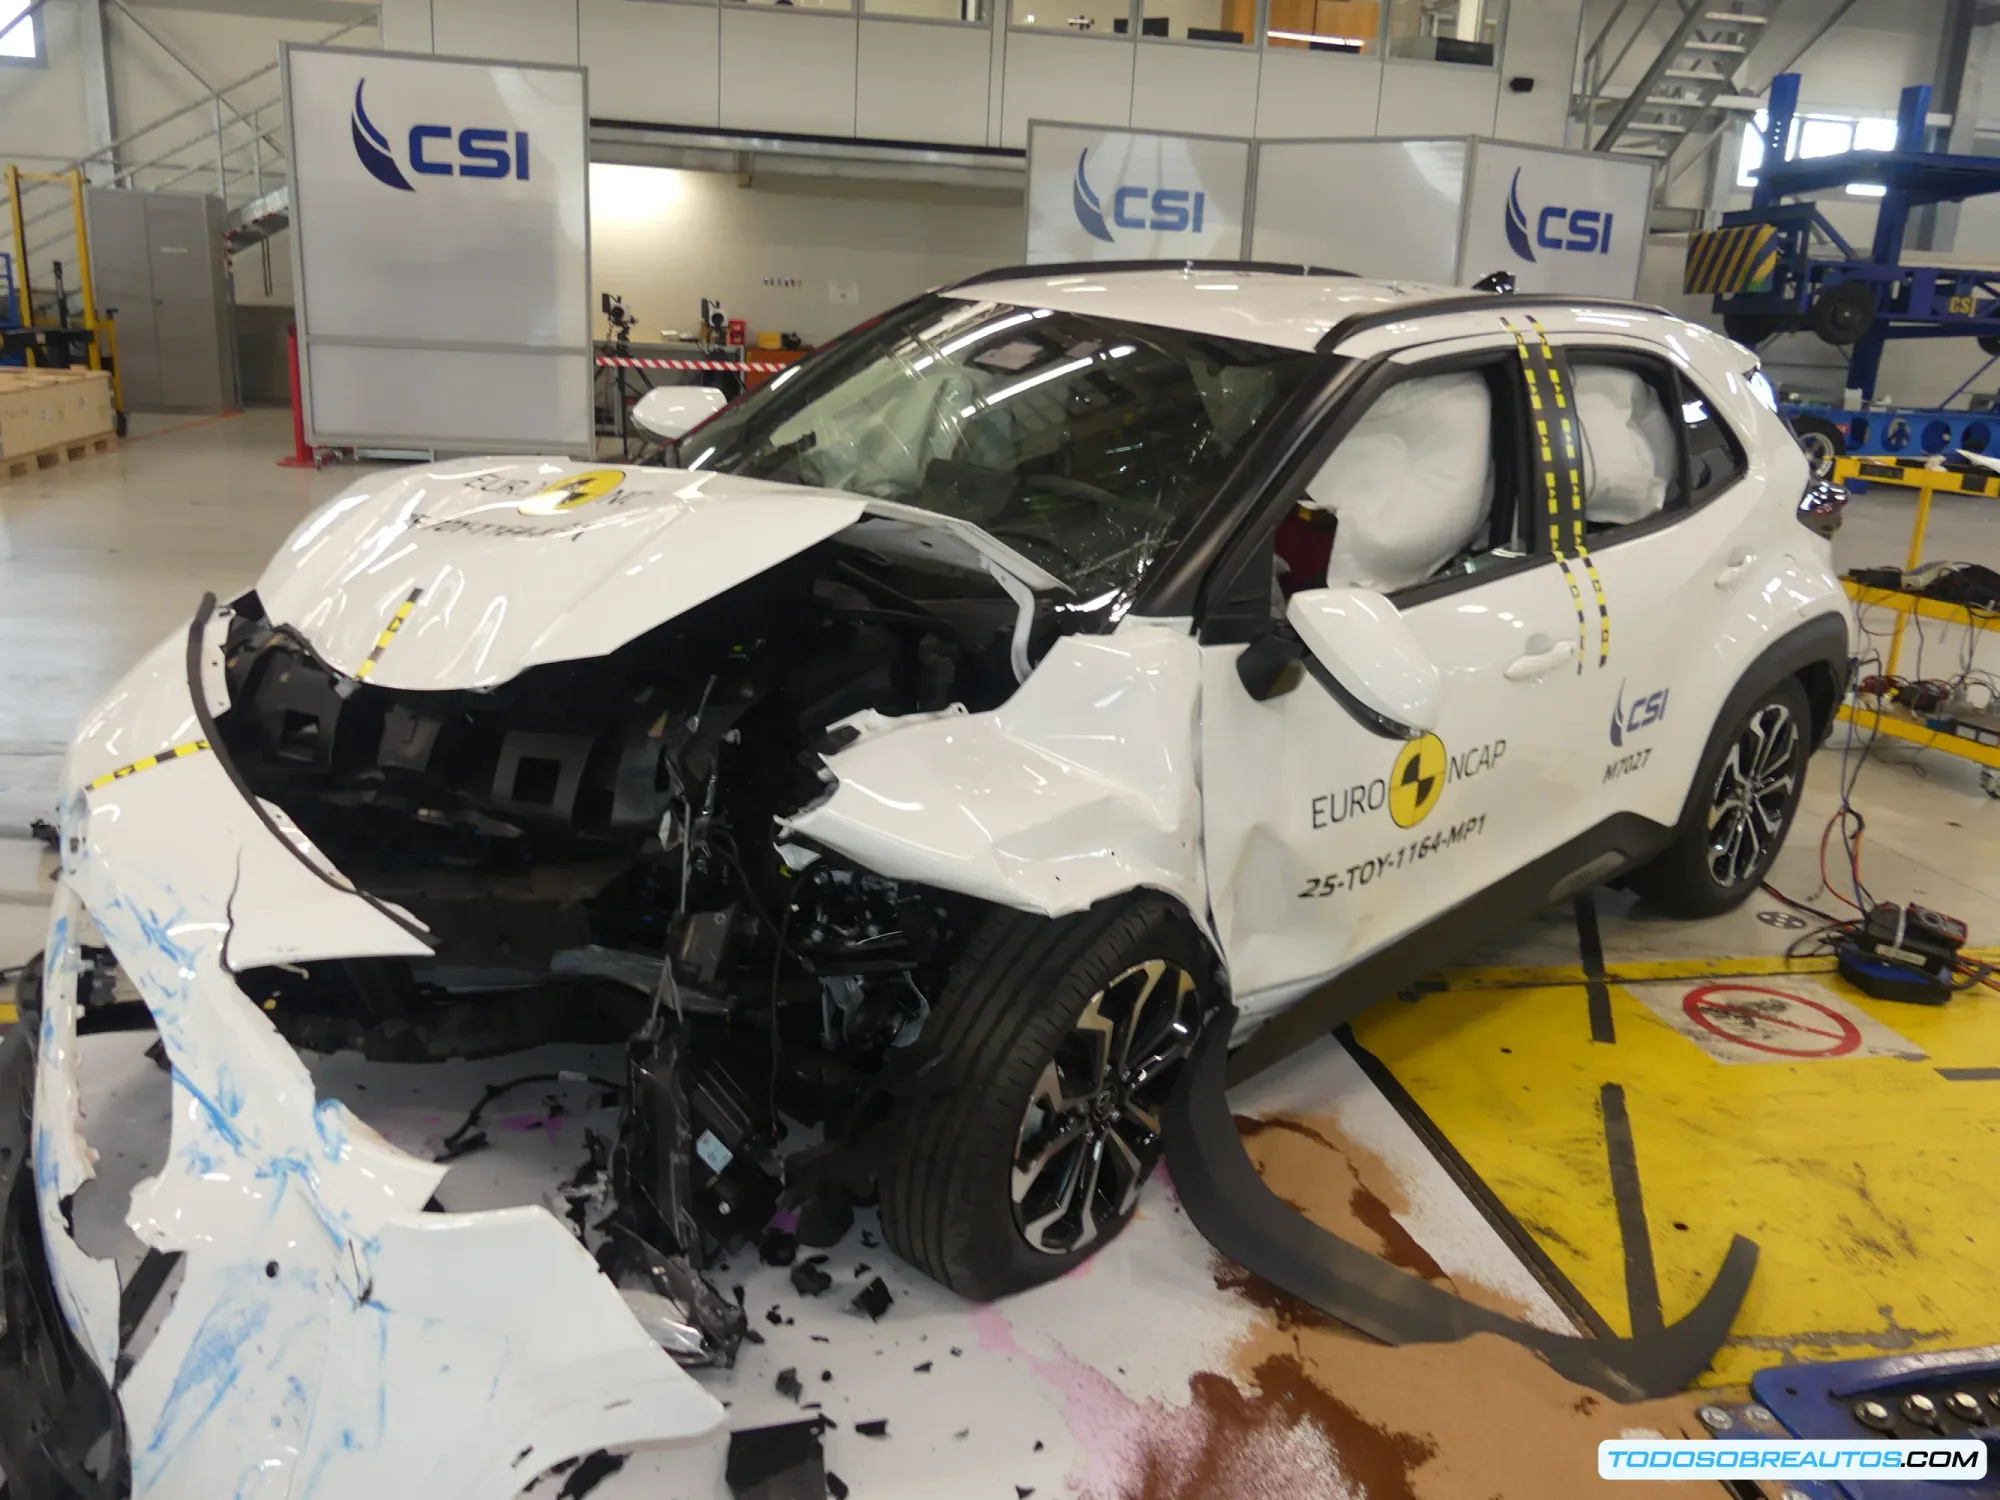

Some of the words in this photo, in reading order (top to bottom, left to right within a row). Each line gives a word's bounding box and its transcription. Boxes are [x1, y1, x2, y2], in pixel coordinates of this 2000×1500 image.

[408, 124, 530, 181] CSI
[1114, 186, 1205, 233] CSI
[1537, 206, 1613, 254] CSI
[1948, 296, 1977, 315] CSI
[1626, 687, 1669, 732] CSI
[1311, 778, 1386, 830] EURO
[1448, 739, 1507, 784] NCAP
[1602, 747, 1652, 784] M7027
[1297, 813, 1487, 899] 25-TOY-1164-MP1
